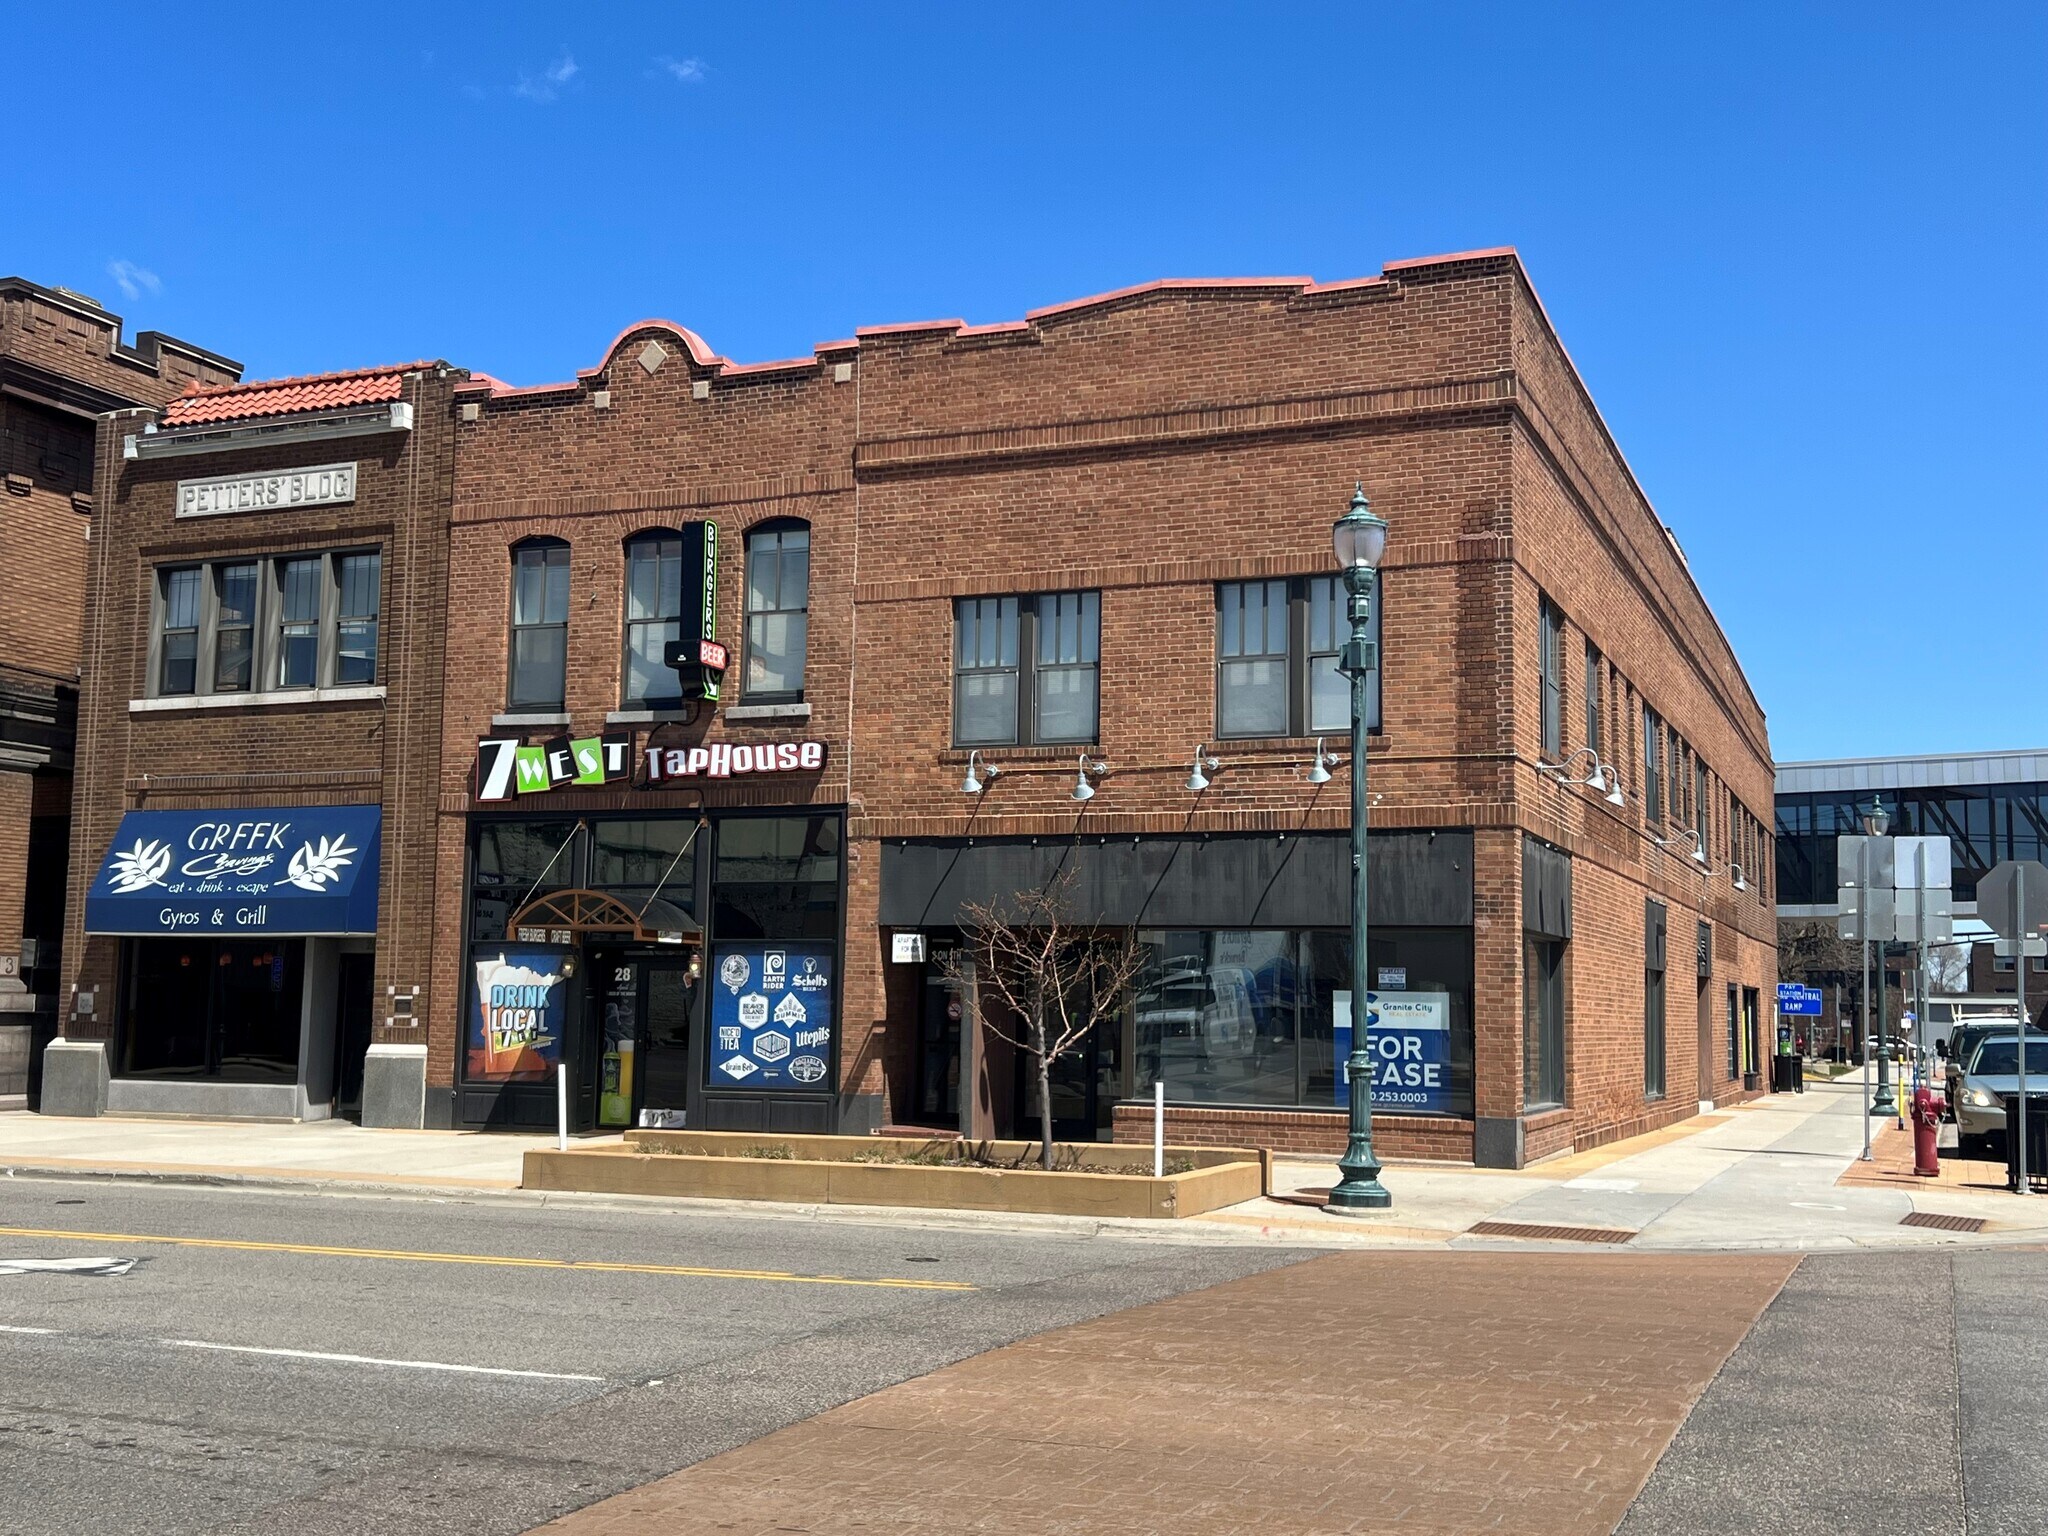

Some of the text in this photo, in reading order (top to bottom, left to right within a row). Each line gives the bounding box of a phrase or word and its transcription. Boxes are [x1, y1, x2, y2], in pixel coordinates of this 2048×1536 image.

[705, 525, 715, 640] BURGERS
[701, 643, 725, 667] BEER
[479, 740, 519, 800] 7
[518, 742, 628, 785] WEST
[168, 880, 269, 895] eat drink escape
[159, 905, 267, 930] Gyros & Grill
[614, 967, 631, 982] 28
[791, 974, 828, 987] Schell's
[763, 982, 784, 990] RIDER
[490, 984, 551, 1009] DRINK
[1382, 1003, 1433, 1013] Granite City
[1784, 1003, 1803, 1011] RAMP
[490, 1009, 549, 1033] LOCAL
[775, 1010, 805, 1020] SUMMIT
[724, 1038, 740, 1050] TEA
[795, 1026, 831, 1048] Utepils
[725, 1062, 754, 1072] Grain Belt
[1371, 1091, 1428, 1103] 0.253.0003
